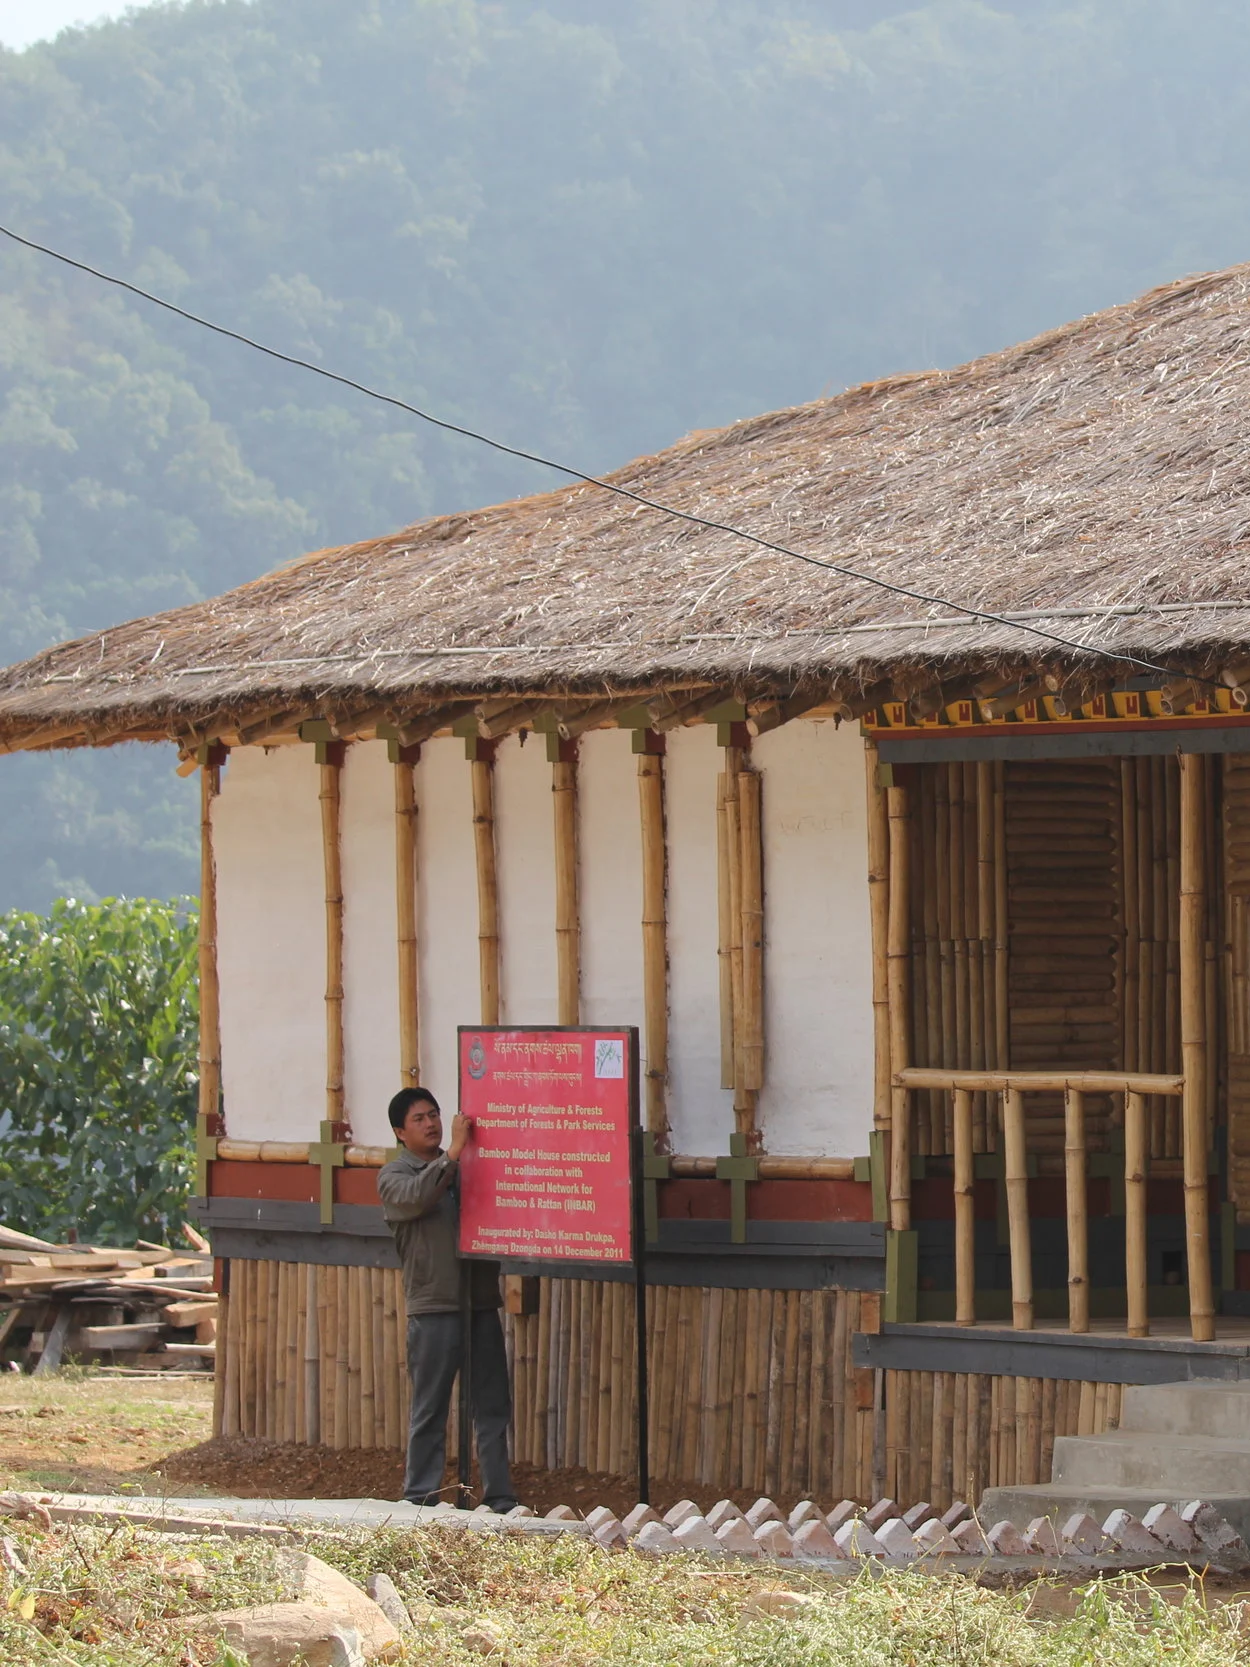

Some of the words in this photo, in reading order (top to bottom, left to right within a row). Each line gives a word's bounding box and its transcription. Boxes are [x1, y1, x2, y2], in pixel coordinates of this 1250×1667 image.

[487, 1103, 515, 1117] Ministry
[518, 1104, 526, 1113] of
[527, 1104, 565, 1116] Agriculture
[567, 1105, 573, 1114] &
[576, 1105, 603, 1115] Forests
[476, 1117, 517, 1130] Department
[520, 1119, 528, 1129] of
[529, 1119, 554, 1129] Forests
[556, 1120, 562, 1129] &
[564, 1120, 581, 1129] Park
[583, 1121, 615, 1131] Services
[479, 1148, 510, 1159] Bamboo
[512, 1149, 535, 1159] Model
[538, 1150, 560, 1160] House
[562, 1151, 611, 1162] constructed
[505, 1165, 512, 1175] in
[514, 1165, 563, 1176] collaboration
[565, 1168, 583, 1177] with
[496, 1180, 545, 1192] International
[547, 1182, 580, 1194] Network
[581, 1184, 592, 1194] for
[496, 1196, 527, 1207] Bamboo
[530, 1198, 535, 1208] &
[538, 1198, 562, 1209] Rattan
[564, 1200, 596, 1213] (INBAR)
[478, 1226, 521, 1238] Inaugurated
[523, 1228, 533, 1239] by:
[535, 1229, 556, 1239] Dasho
[559, 1230, 583, 1241] Karma
[586, 1232, 615, 1244] Drukpa,
[511, 1242, 541, 1256] Dzongda
[554, 1244, 563, 1255] 14
[565, 1246, 603, 1257] December
[605, 1248, 623, 1258] 2011
